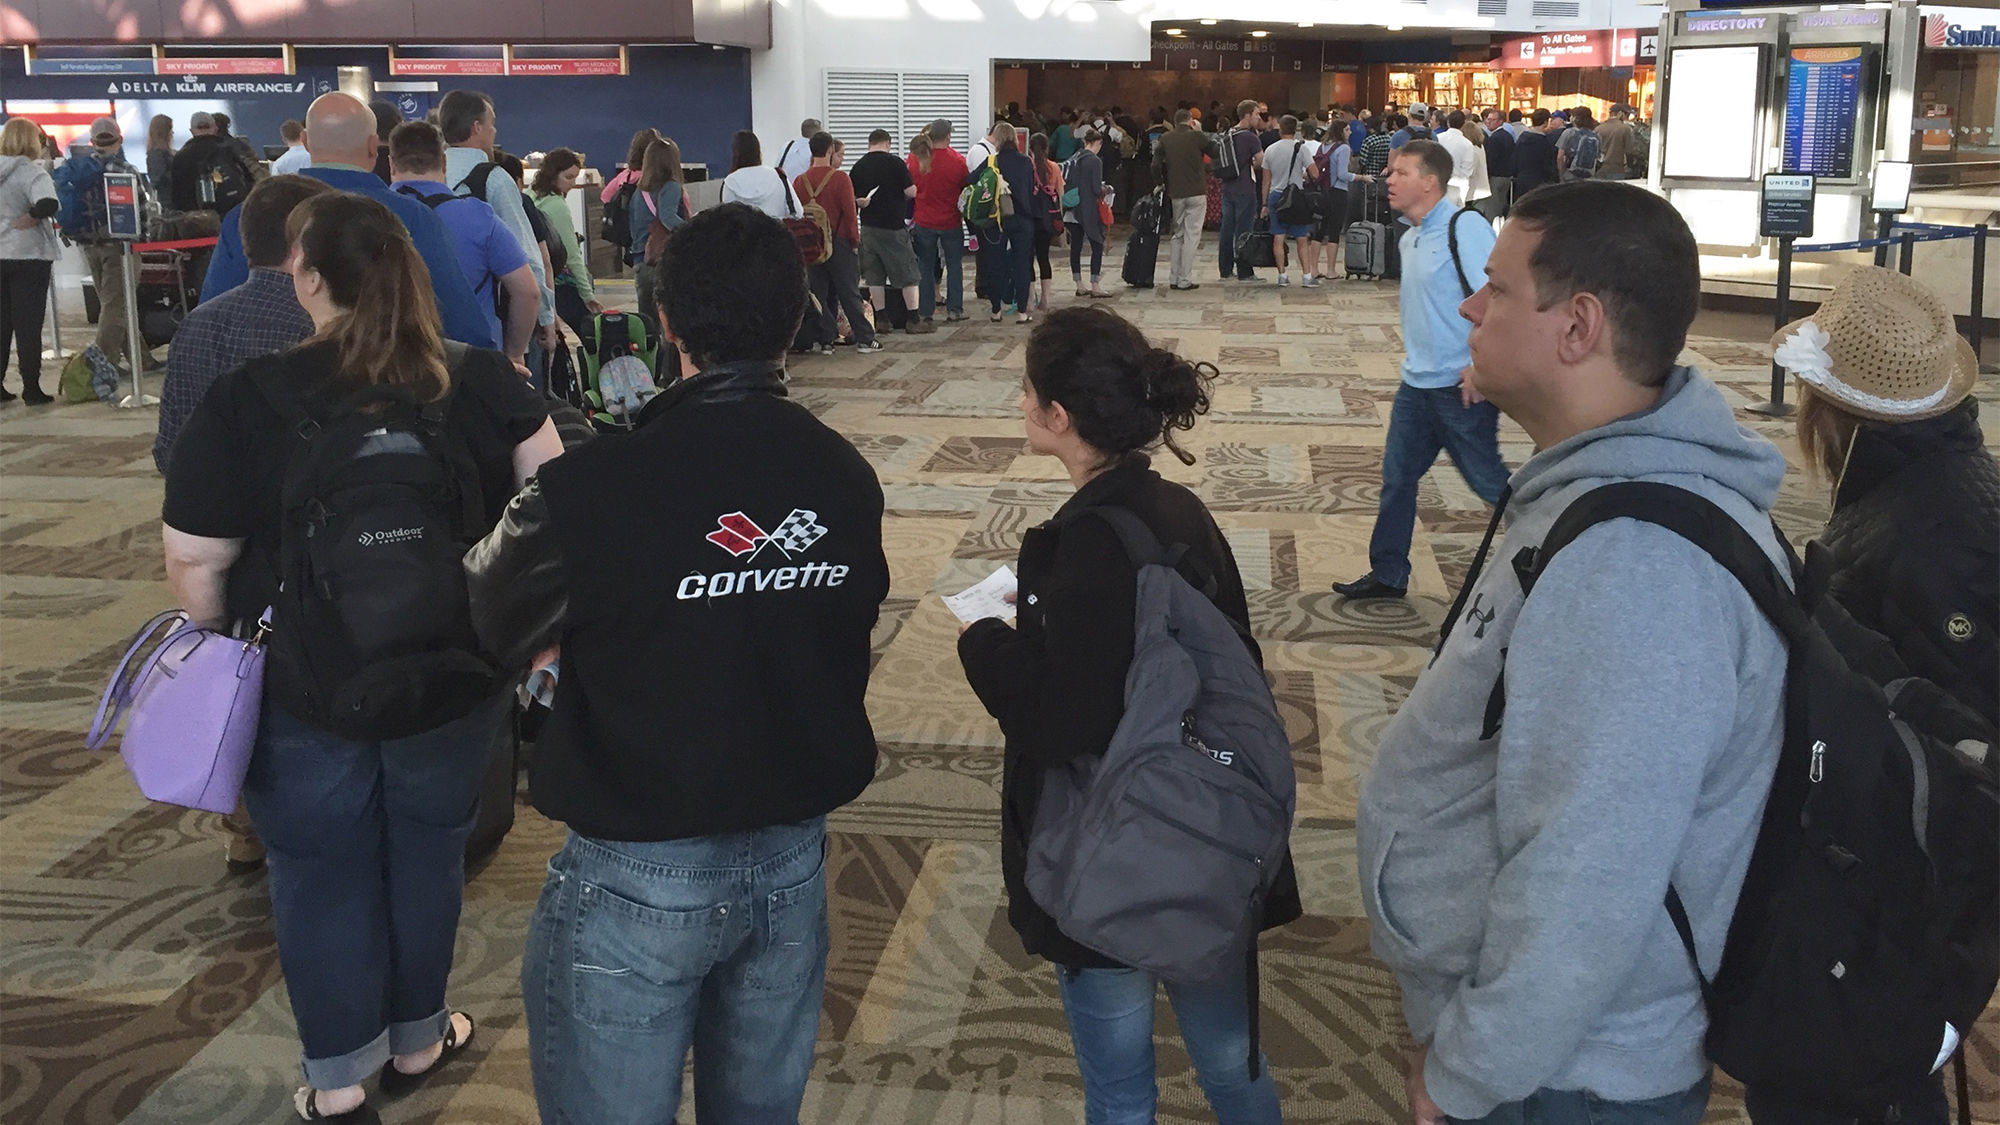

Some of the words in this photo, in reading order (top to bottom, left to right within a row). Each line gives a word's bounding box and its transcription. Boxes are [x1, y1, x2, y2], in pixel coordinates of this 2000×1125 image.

[1687, 17, 1767, 32] DIRECTORY
[1541, 35, 1551, 44] To
[1552, 34, 1562, 44] All
[1563, 33, 1587, 43] Gates
[1202, 40, 1213, 50] All
[1214, 40, 1239, 51] Gates
[1804, 50, 1849, 60] ARRIVALS
[122, 82, 169, 93] DELTA
[176, 82, 206, 93] KLM
[213, 82, 292, 93] AIRFRANCE
[375, 526, 424, 540] Outdoor
[676, 561, 850, 600] corvette
